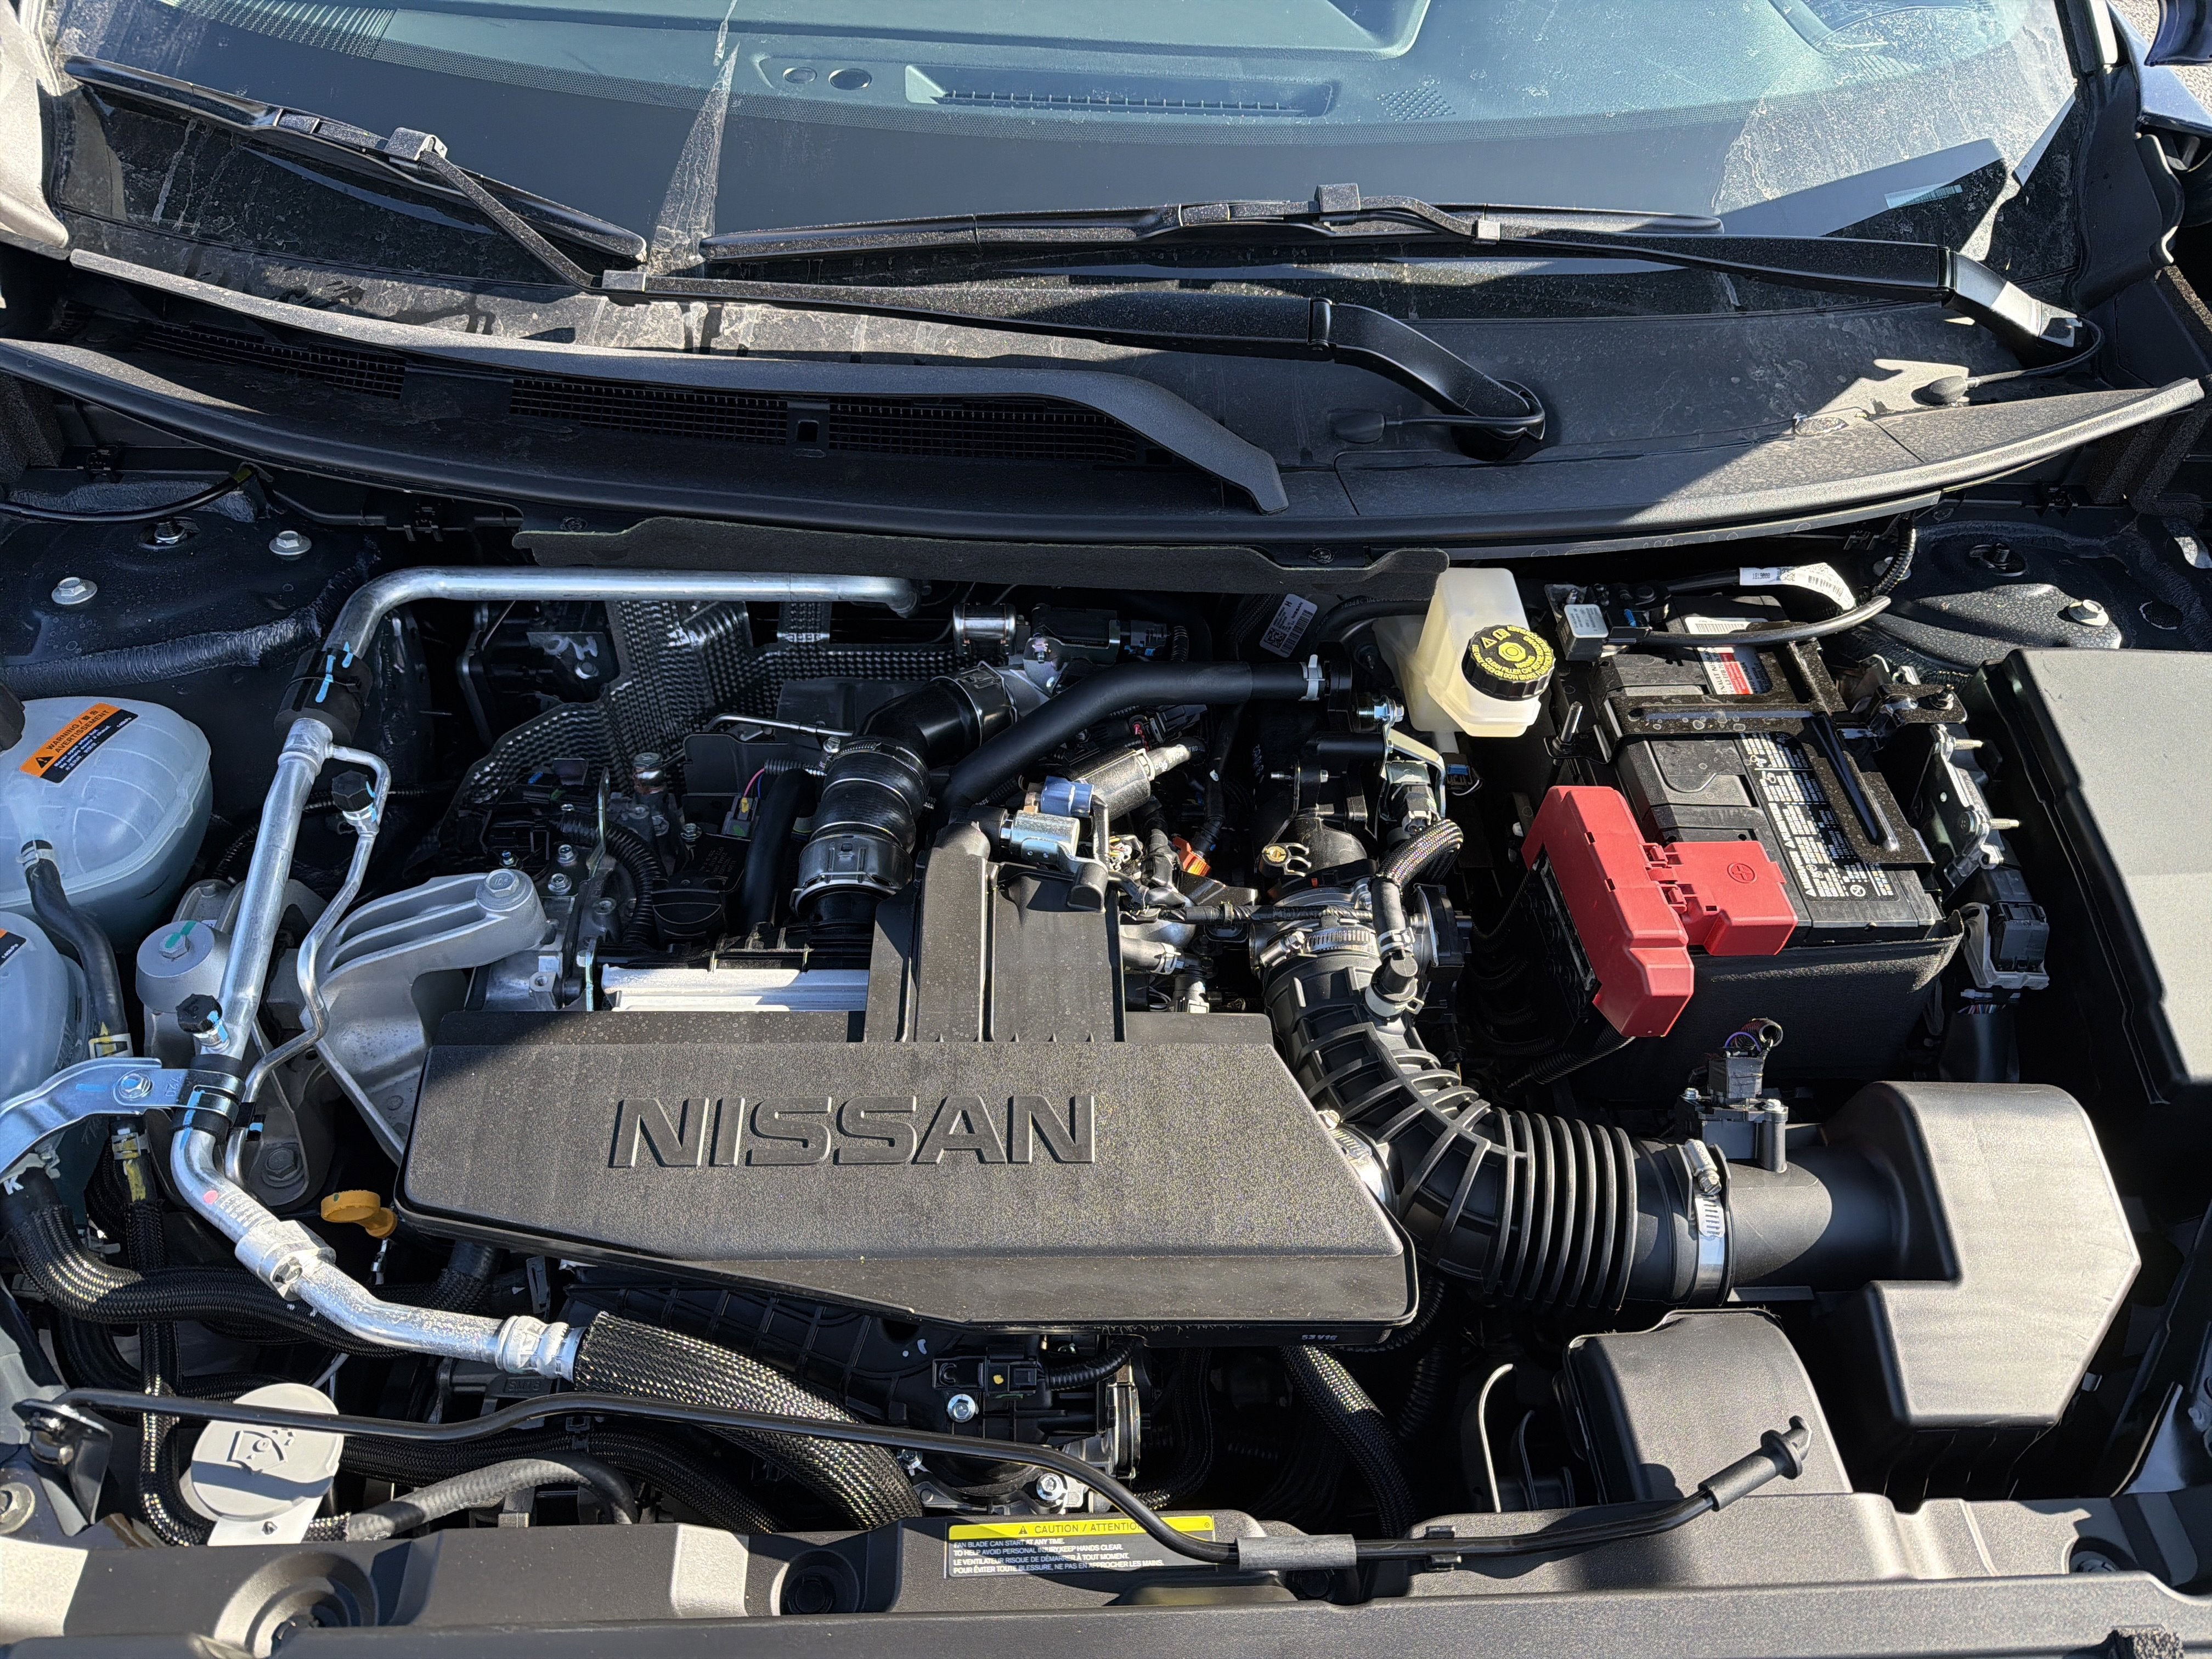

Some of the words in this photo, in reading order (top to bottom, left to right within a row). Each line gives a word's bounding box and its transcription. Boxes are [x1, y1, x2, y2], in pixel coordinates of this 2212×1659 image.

[1284, 600, 1293, 608] H
[1485, 657, 1503, 670] CLEAN
[1502, 667, 1522, 675] FILLER
[1514, 655, 1536, 669] WARNING
[1481, 662, 1496, 673] DOT3
[1519, 672, 1538, 680] BRAKE
[46, 723, 80, 749] WARNING
[54, 709, 109, 753] AVERTISSEMENT
[608, 1096, 1095, 1168] NISSAN
[1034, 1525, 1079, 1534] CAUTION
[1040, 1554, 1075, 1562] DÉMARRER
[1076, 1553, 1082, 1561] À
[974, 1565, 996, 1573] ÉVITER
